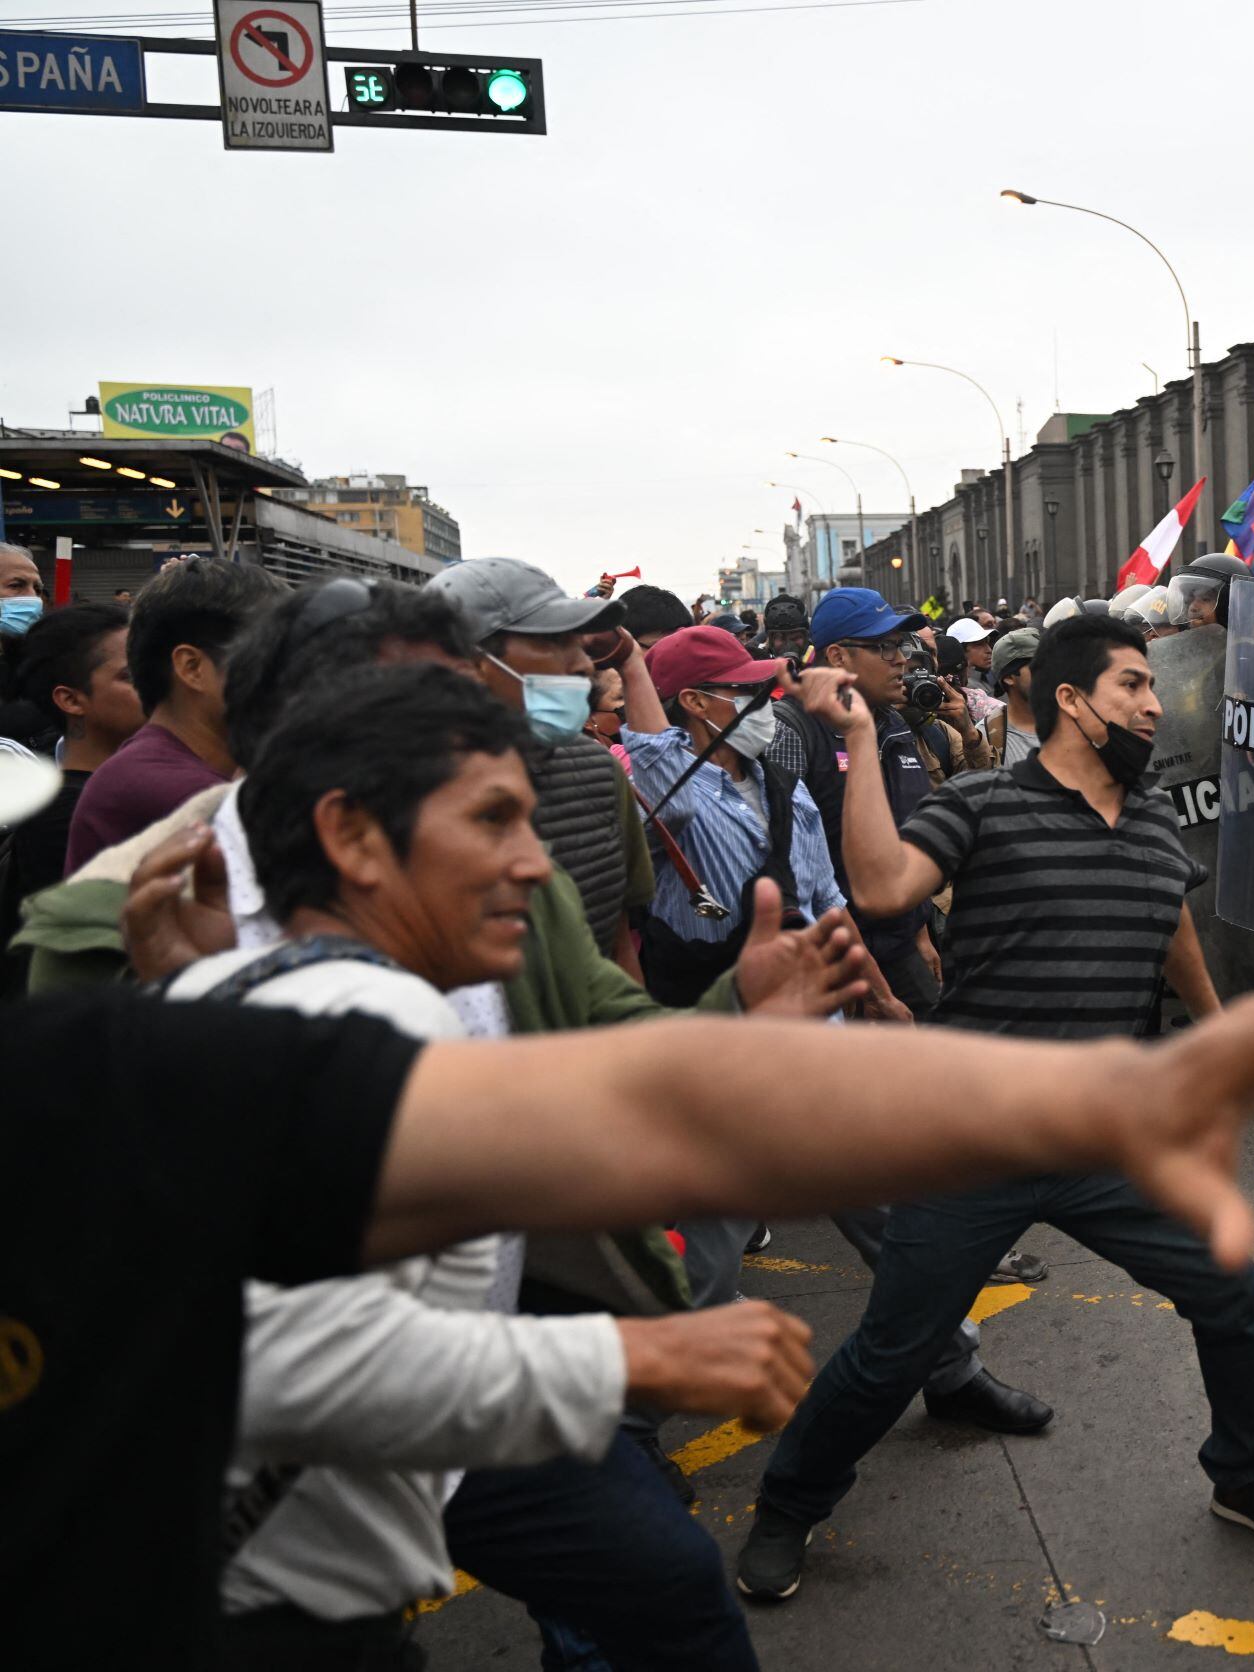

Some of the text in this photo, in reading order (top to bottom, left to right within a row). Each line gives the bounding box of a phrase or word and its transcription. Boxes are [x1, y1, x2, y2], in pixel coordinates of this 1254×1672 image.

[228, 96, 324, 117] NO VOLTEAR A
[230, 121, 326, 140] LA IZQUIERDA
[115, 402, 240, 426] NATURA VITAL
